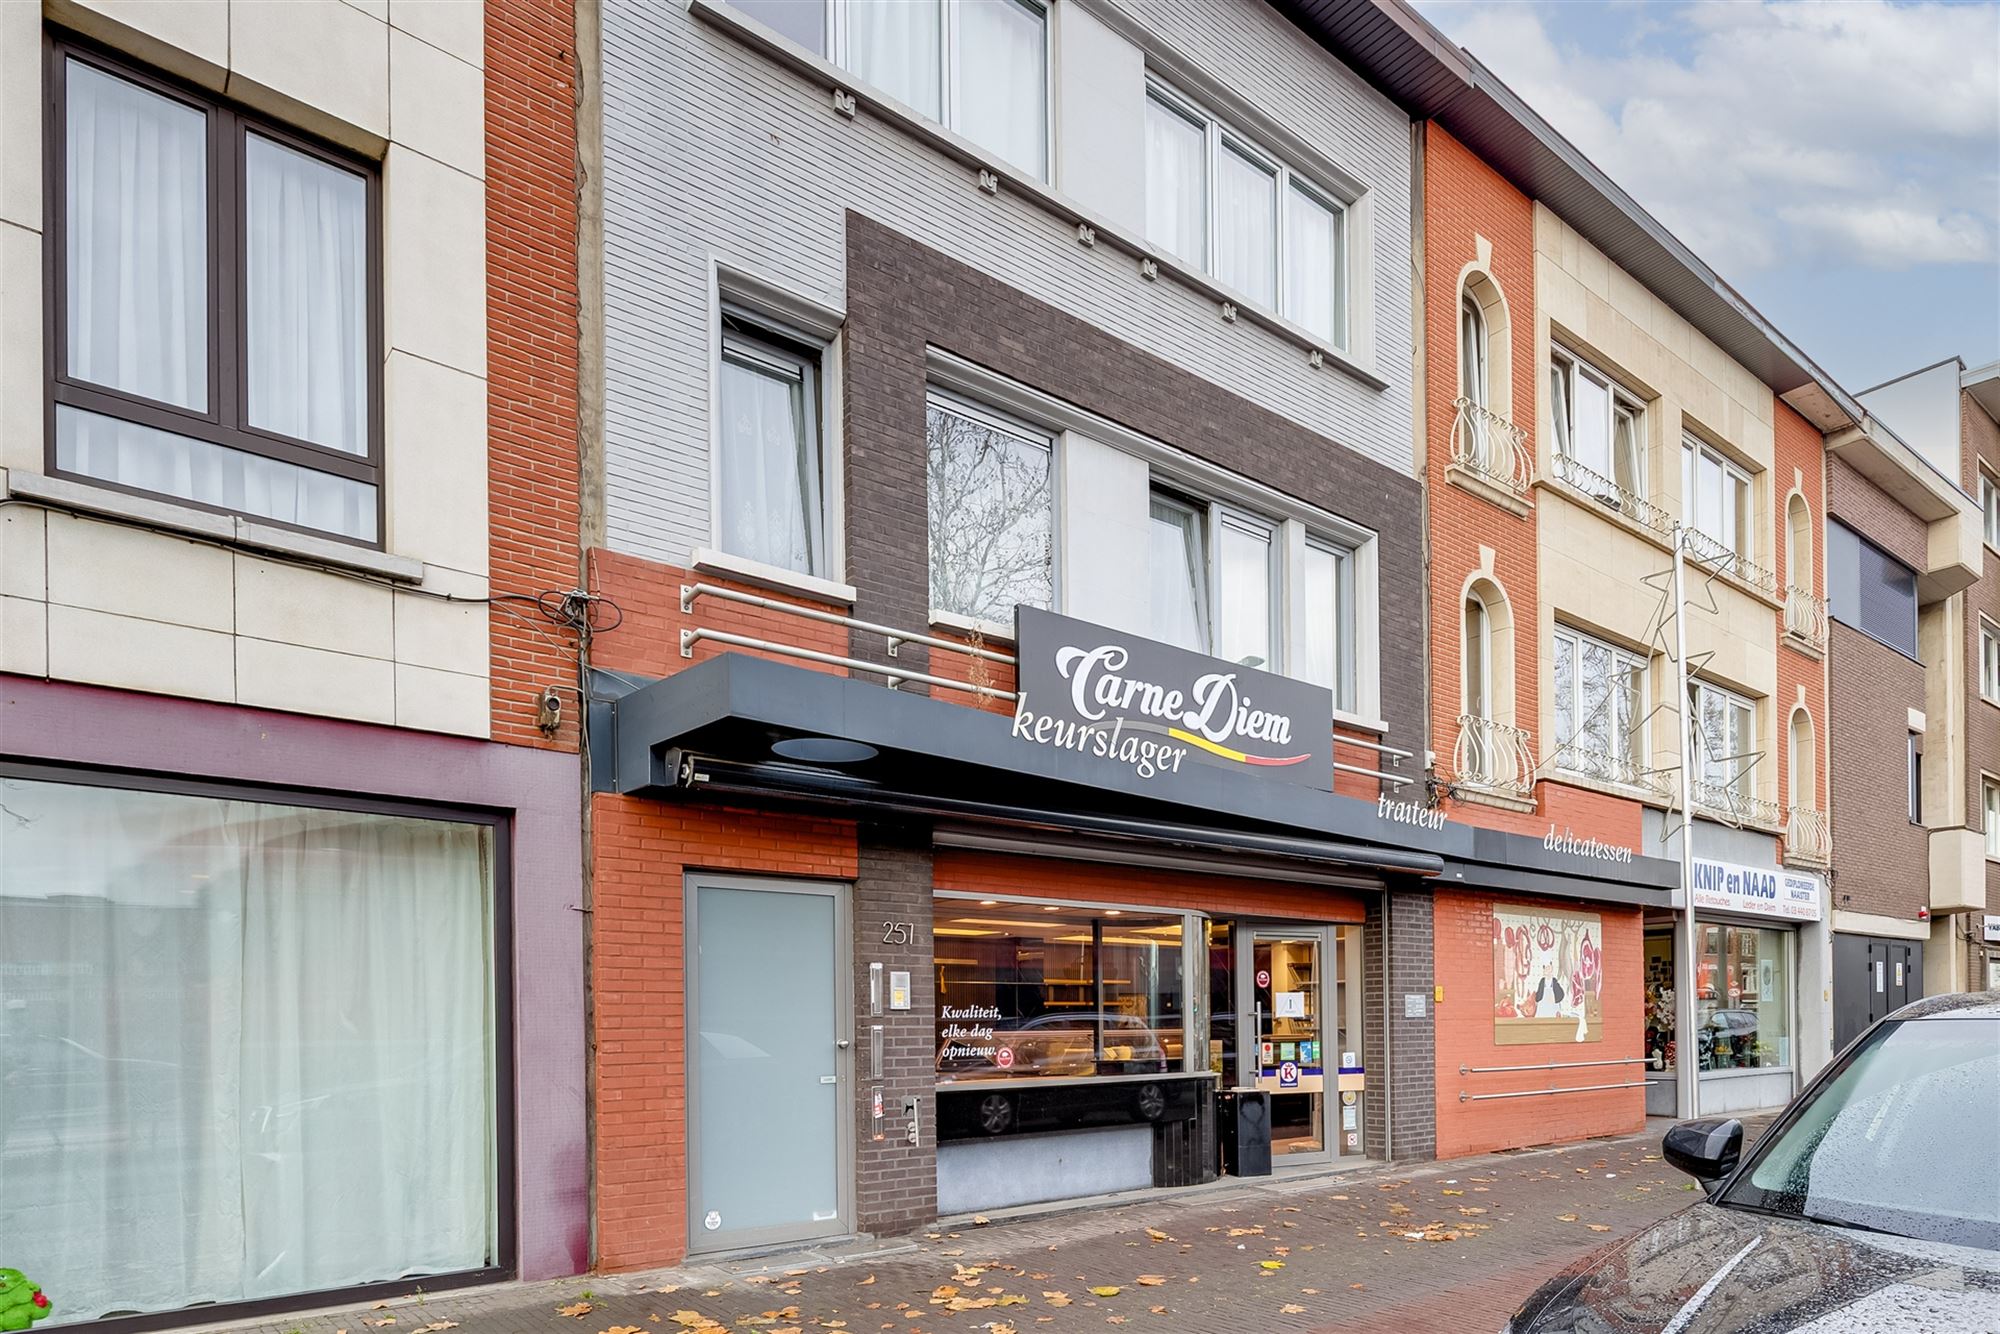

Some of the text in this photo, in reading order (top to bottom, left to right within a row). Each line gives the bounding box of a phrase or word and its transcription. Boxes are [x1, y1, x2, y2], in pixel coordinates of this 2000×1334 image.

[1055, 645, 1293, 745] Carne Diem
[1011, 692, 1187, 779] keurslager
[1377, 792, 1448, 832] traiteur
[1543, 824, 1633, 865] delicatessen
[1694, 863, 1776, 899] KNIP en NAAD
[882, 920, 915, 945] 251
[942, 1005, 1002, 1021] Kwaliteit,
[941, 1023, 993, 1041] elke dag
[942, 1044, 997, 1060] opnieuw.
[1284, 1068, 1294, 1079] K
